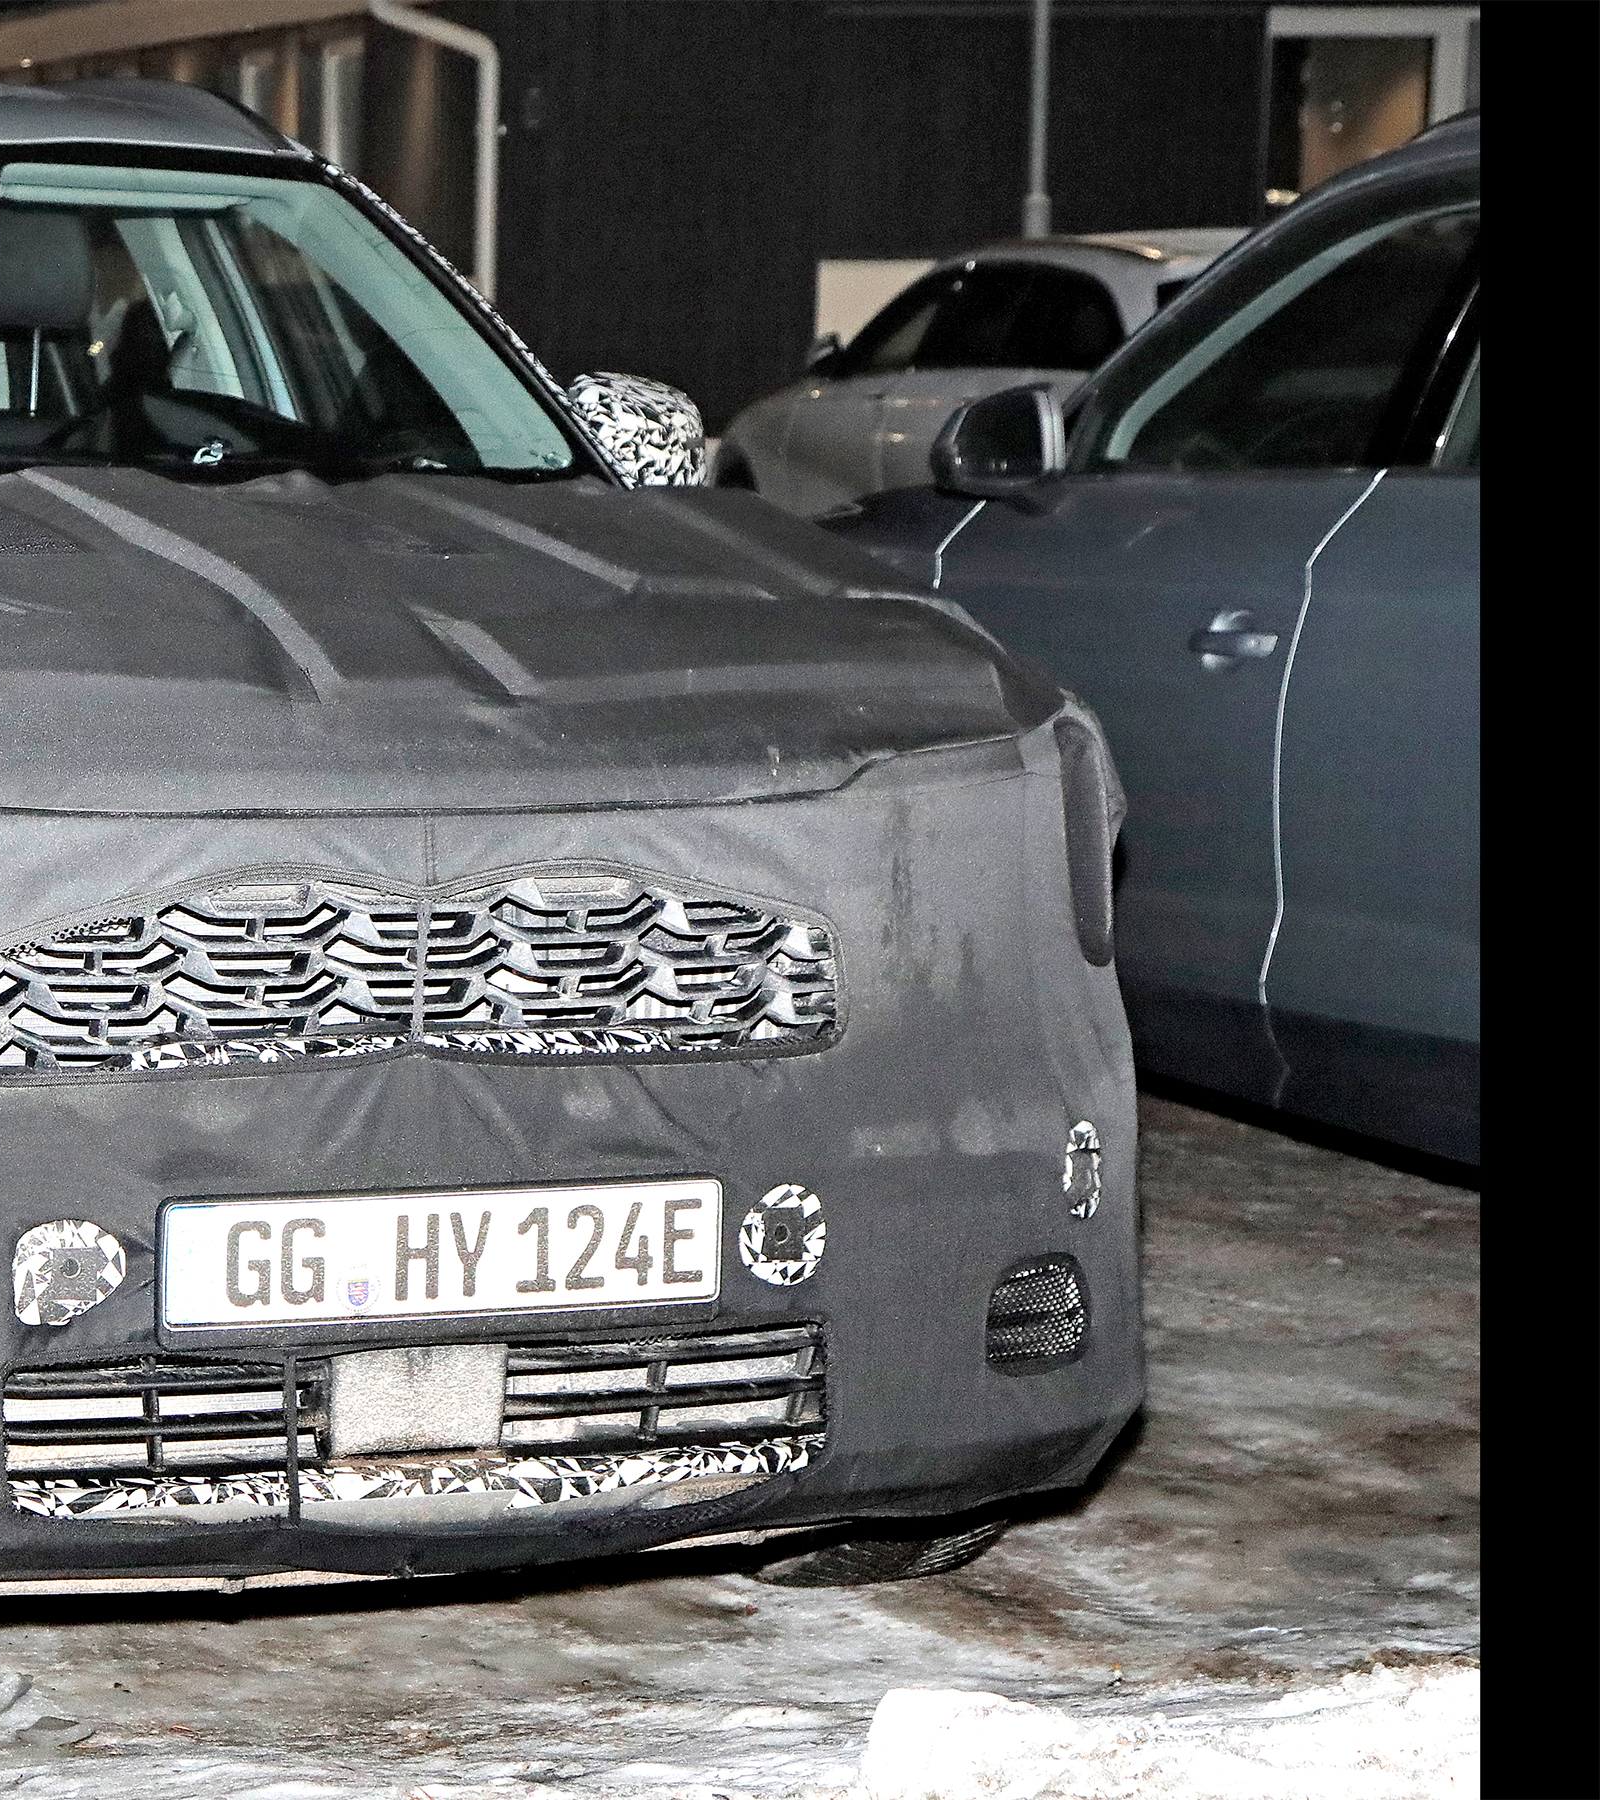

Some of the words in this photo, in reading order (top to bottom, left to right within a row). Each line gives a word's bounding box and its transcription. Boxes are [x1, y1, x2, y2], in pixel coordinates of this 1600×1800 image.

[226, 1218, 325, 1307] GG
[395, 1211, 491, 1301] HY
[516, 1198, 703, 1293] 124E
